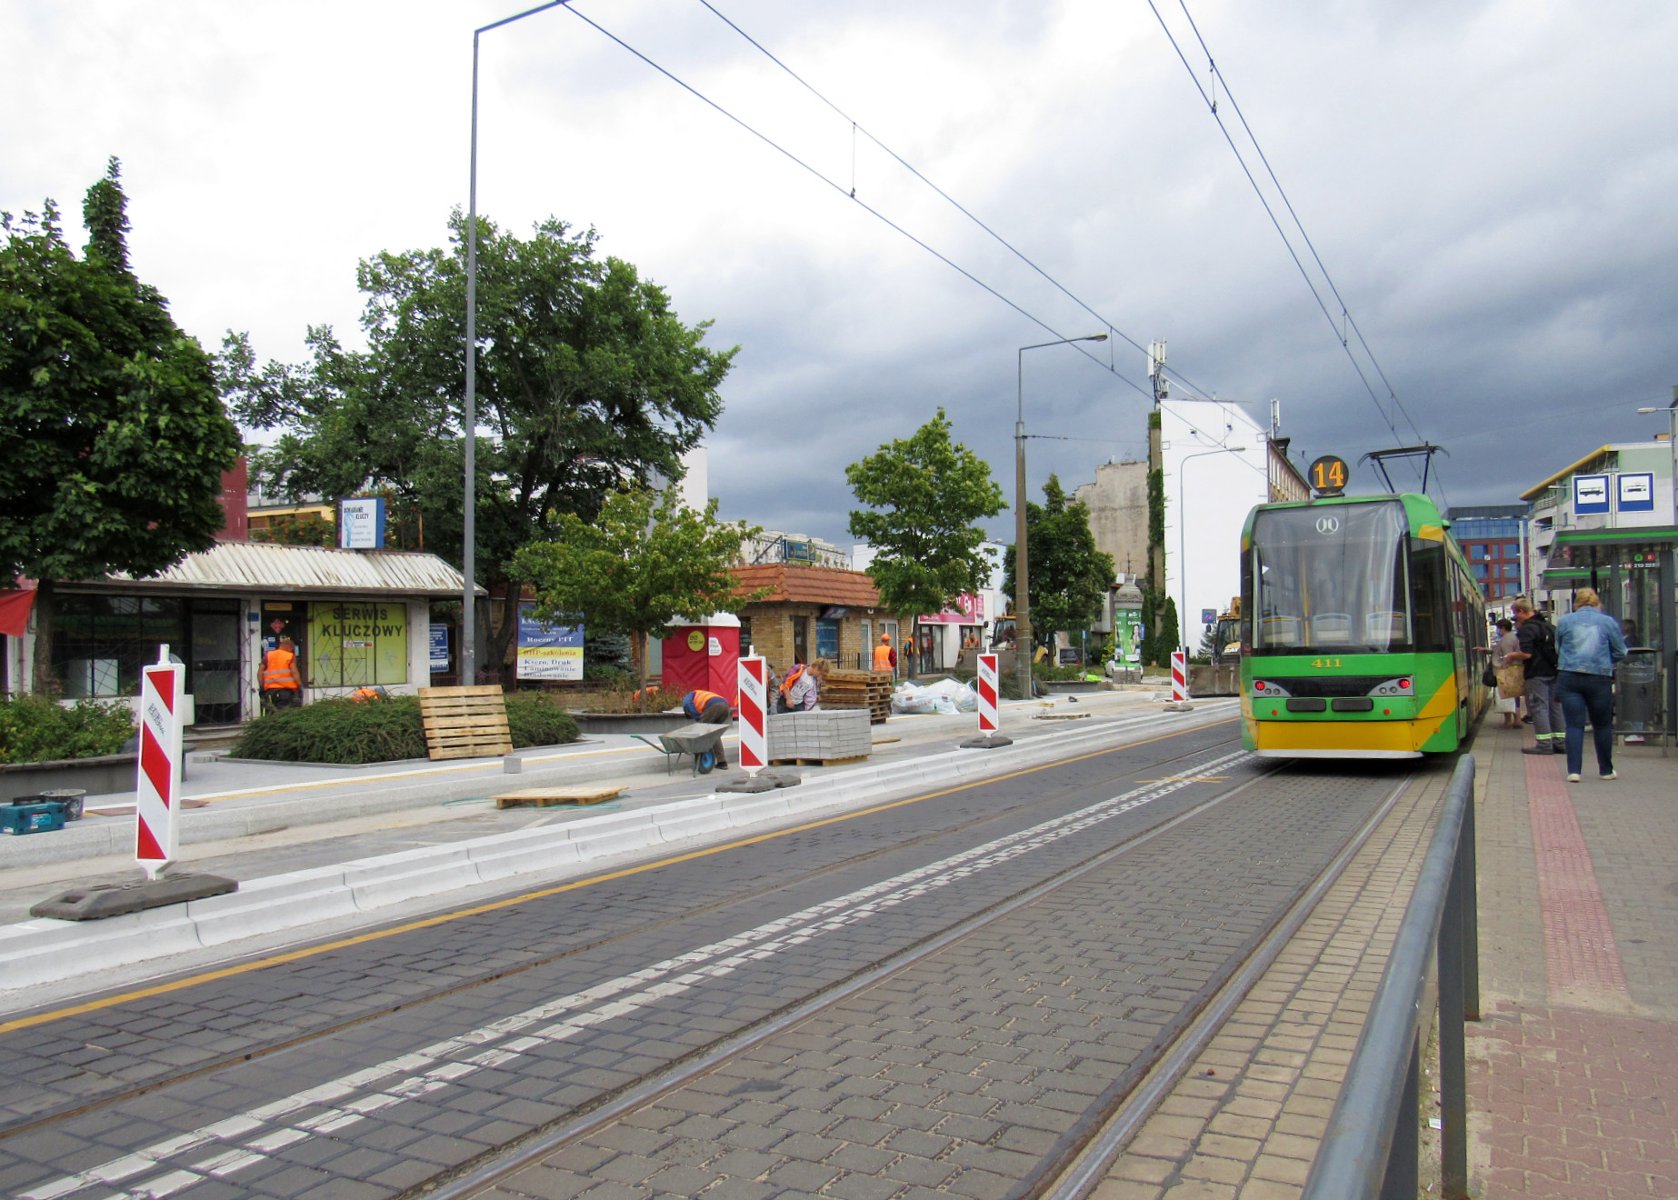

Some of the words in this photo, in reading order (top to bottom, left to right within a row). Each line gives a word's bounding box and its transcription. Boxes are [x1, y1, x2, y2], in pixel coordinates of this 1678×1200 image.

[1314, 461, 1344, 488] 14
[332, 607, 388, 621] SERWIS
[322, 624, 403, 637] KLUCZOWY
[1311, 658, 1343, 668] 411
